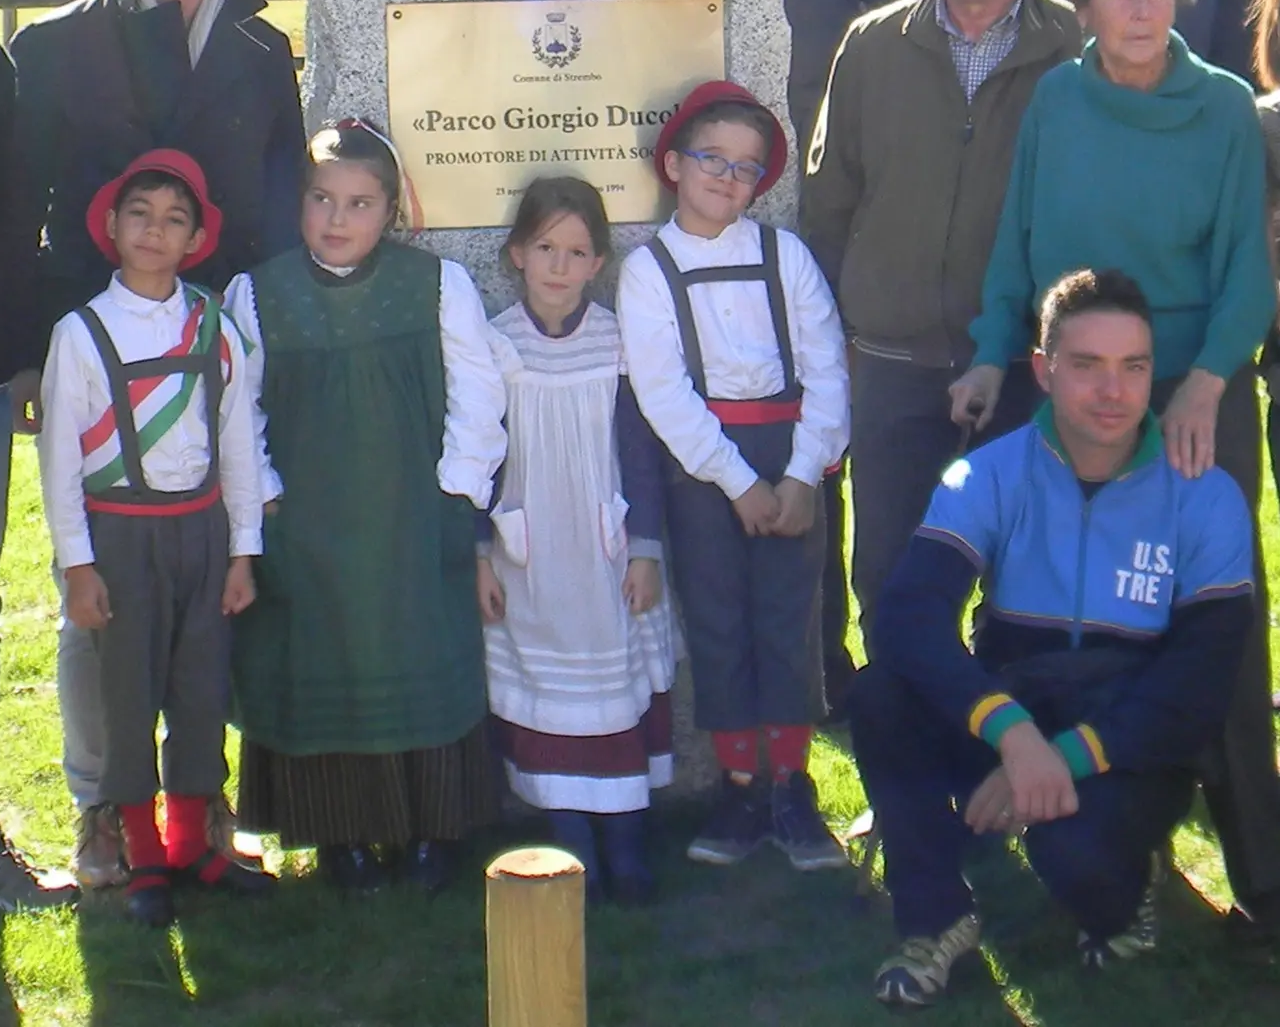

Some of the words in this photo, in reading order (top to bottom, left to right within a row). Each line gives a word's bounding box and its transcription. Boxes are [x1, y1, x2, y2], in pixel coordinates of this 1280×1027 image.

[513, 74, 550, 83] Comune
[553, 73, 562, 82] di
[564, 72, 602, 82] Strembo
[504, 106, 599, 133] Giorgio
[425, 150, 526, 165] PROMOTORE
[529, 150, 547, 162] DI
[551, 145, 626, 162] ATTIVITÀ
[1133, 542, 1174, 575] U.S.
[1116, 570, 1160, 604] TRE
